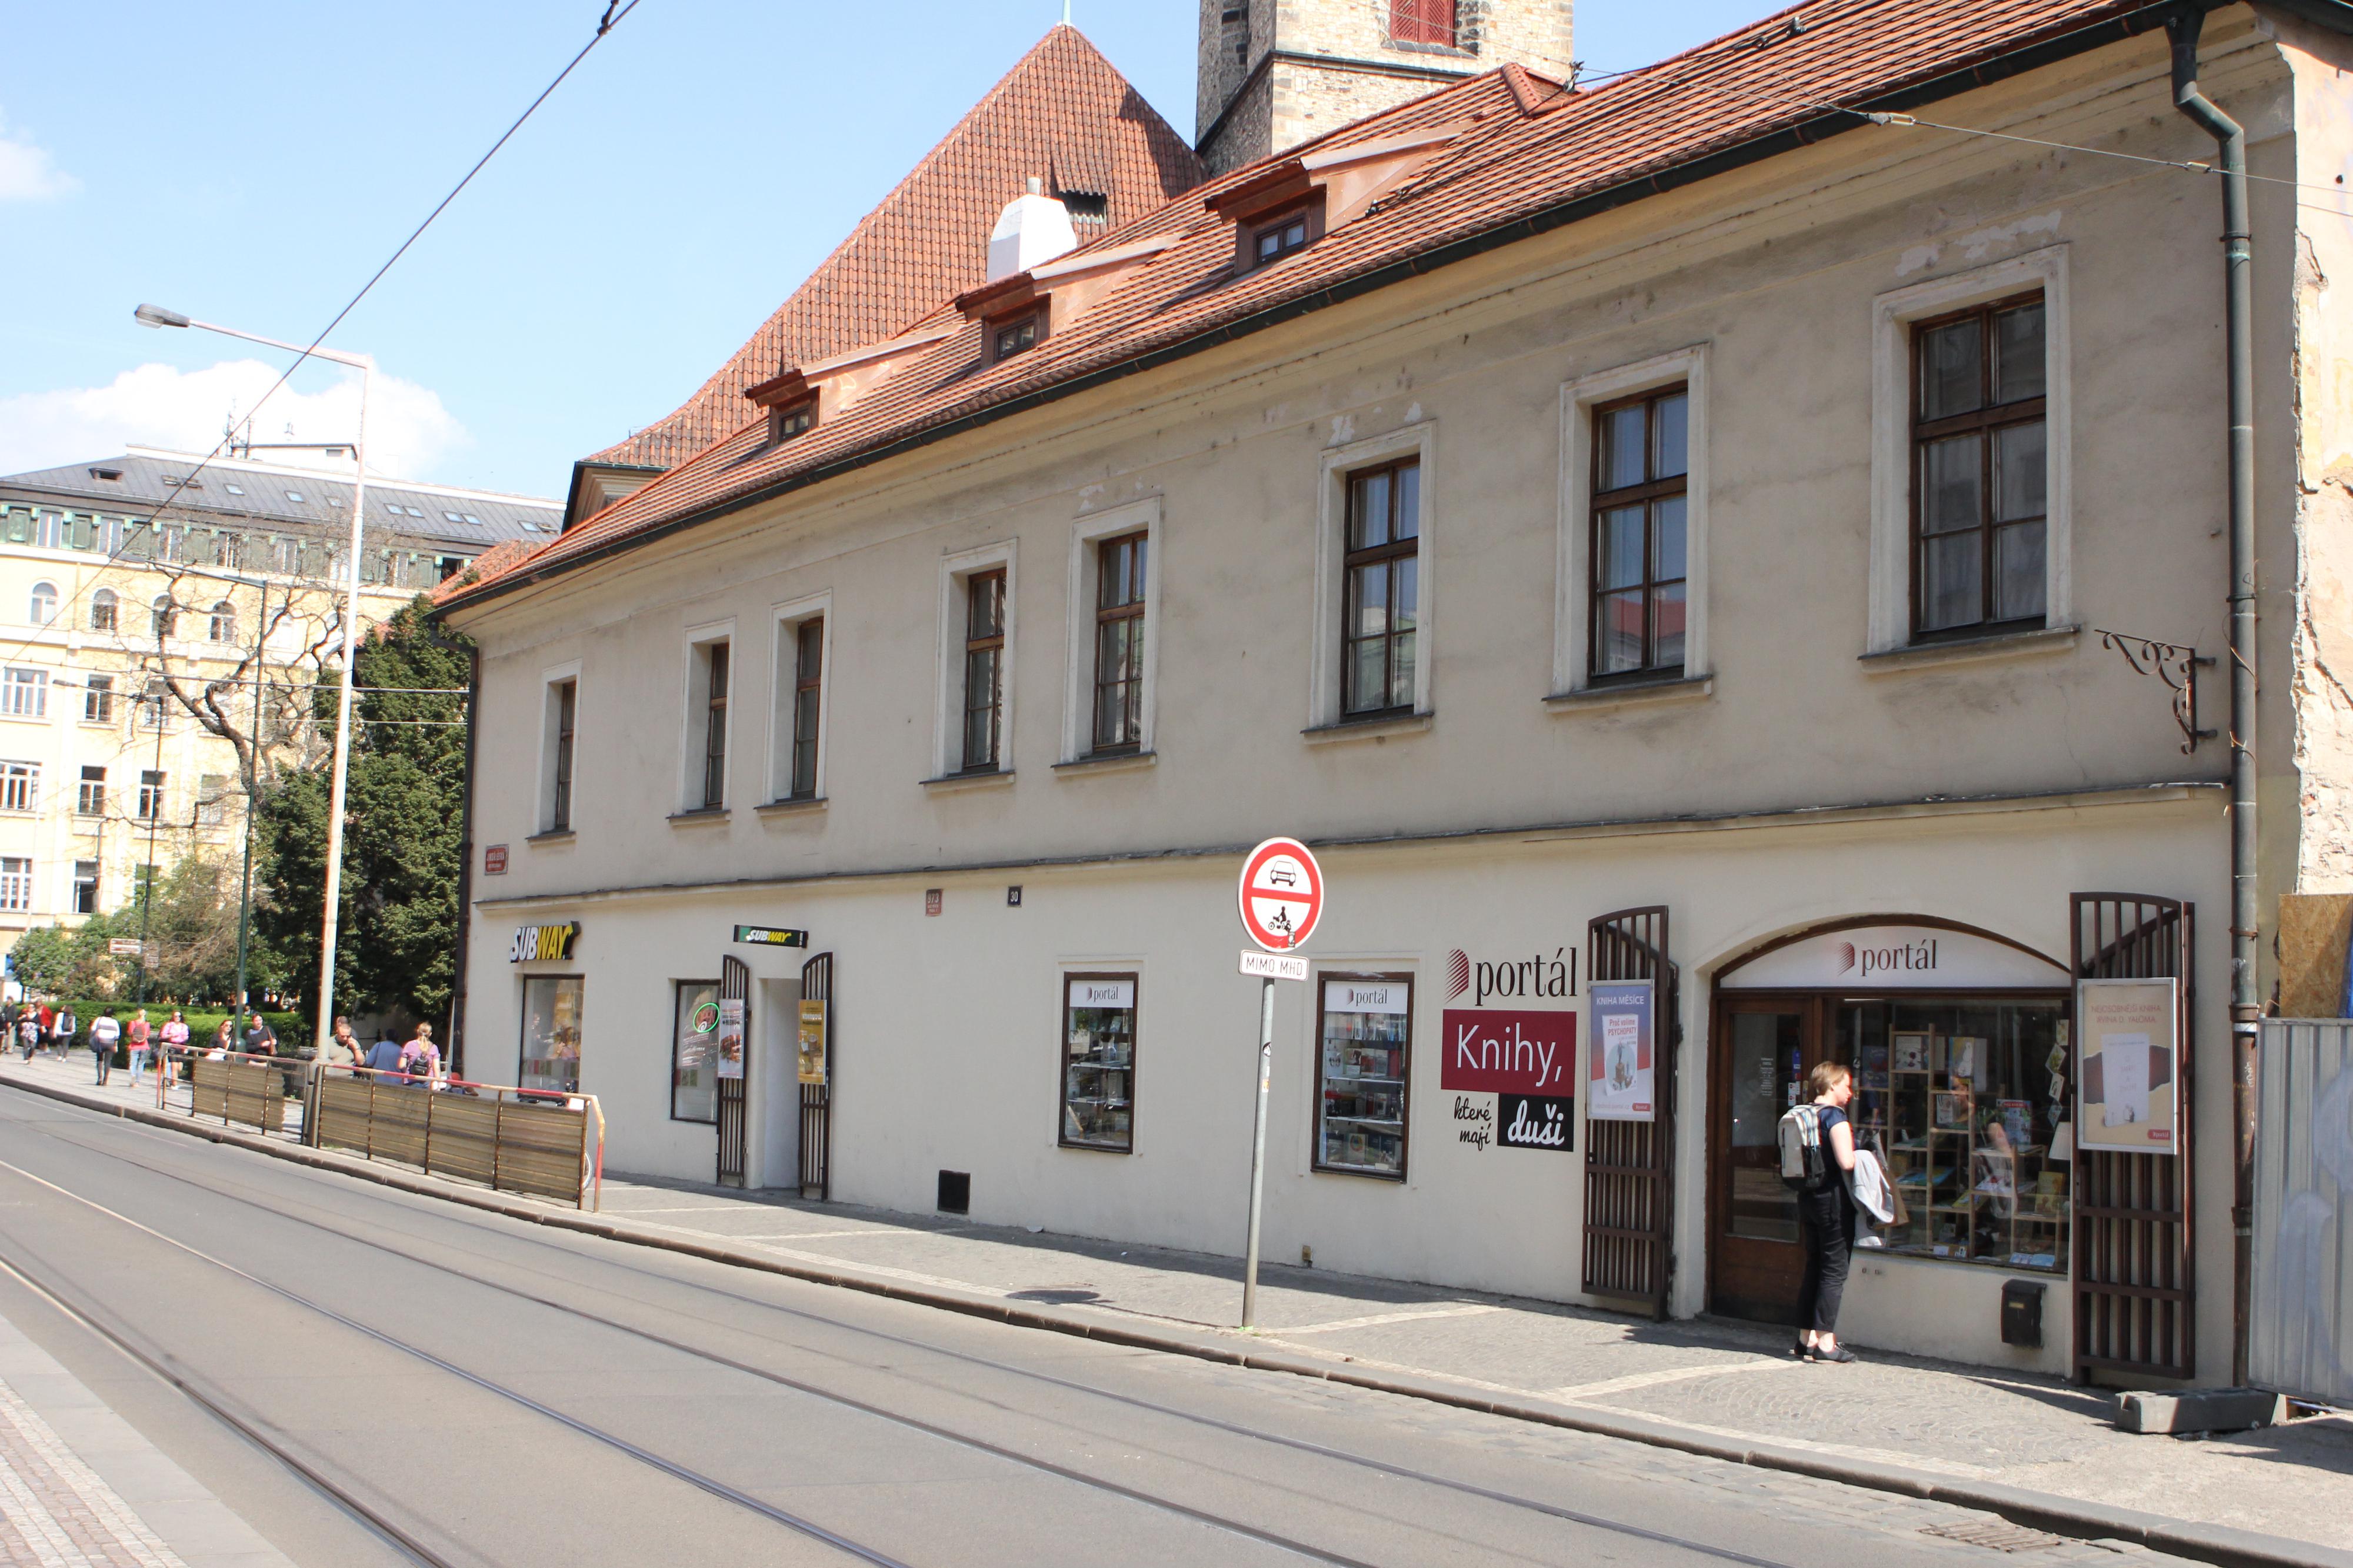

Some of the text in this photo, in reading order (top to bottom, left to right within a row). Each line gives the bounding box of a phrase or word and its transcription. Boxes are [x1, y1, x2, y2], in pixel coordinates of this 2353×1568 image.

[927, 893, 939, 904] 973
[1010, 891, 1018, 902] 30
[509, 925, 574, 961] SUBWAY
[746, 929, 792, 942] SUBWAY
[1246, 956, 1302, 976] MIMO MHD
[1861, 939, 1937, 977] portál
[1475, 947, 1577, 1006] portál
[1094, 986, 1118, 1002] portál
[1355, 988, 1387, 1006] portál
[1596, 995, 1645, 1005] KNIHA MĚSÍCE
[1608, 1026, 1637, 1036] PSYCHOPATY
[1457, 1022, 1562, 1087] Knihy,
[1454, 1095, 1492, 1121] které
[1507, 1099, 1565, 1146] duši
[1459, 1123, 1491, 1152] mají
